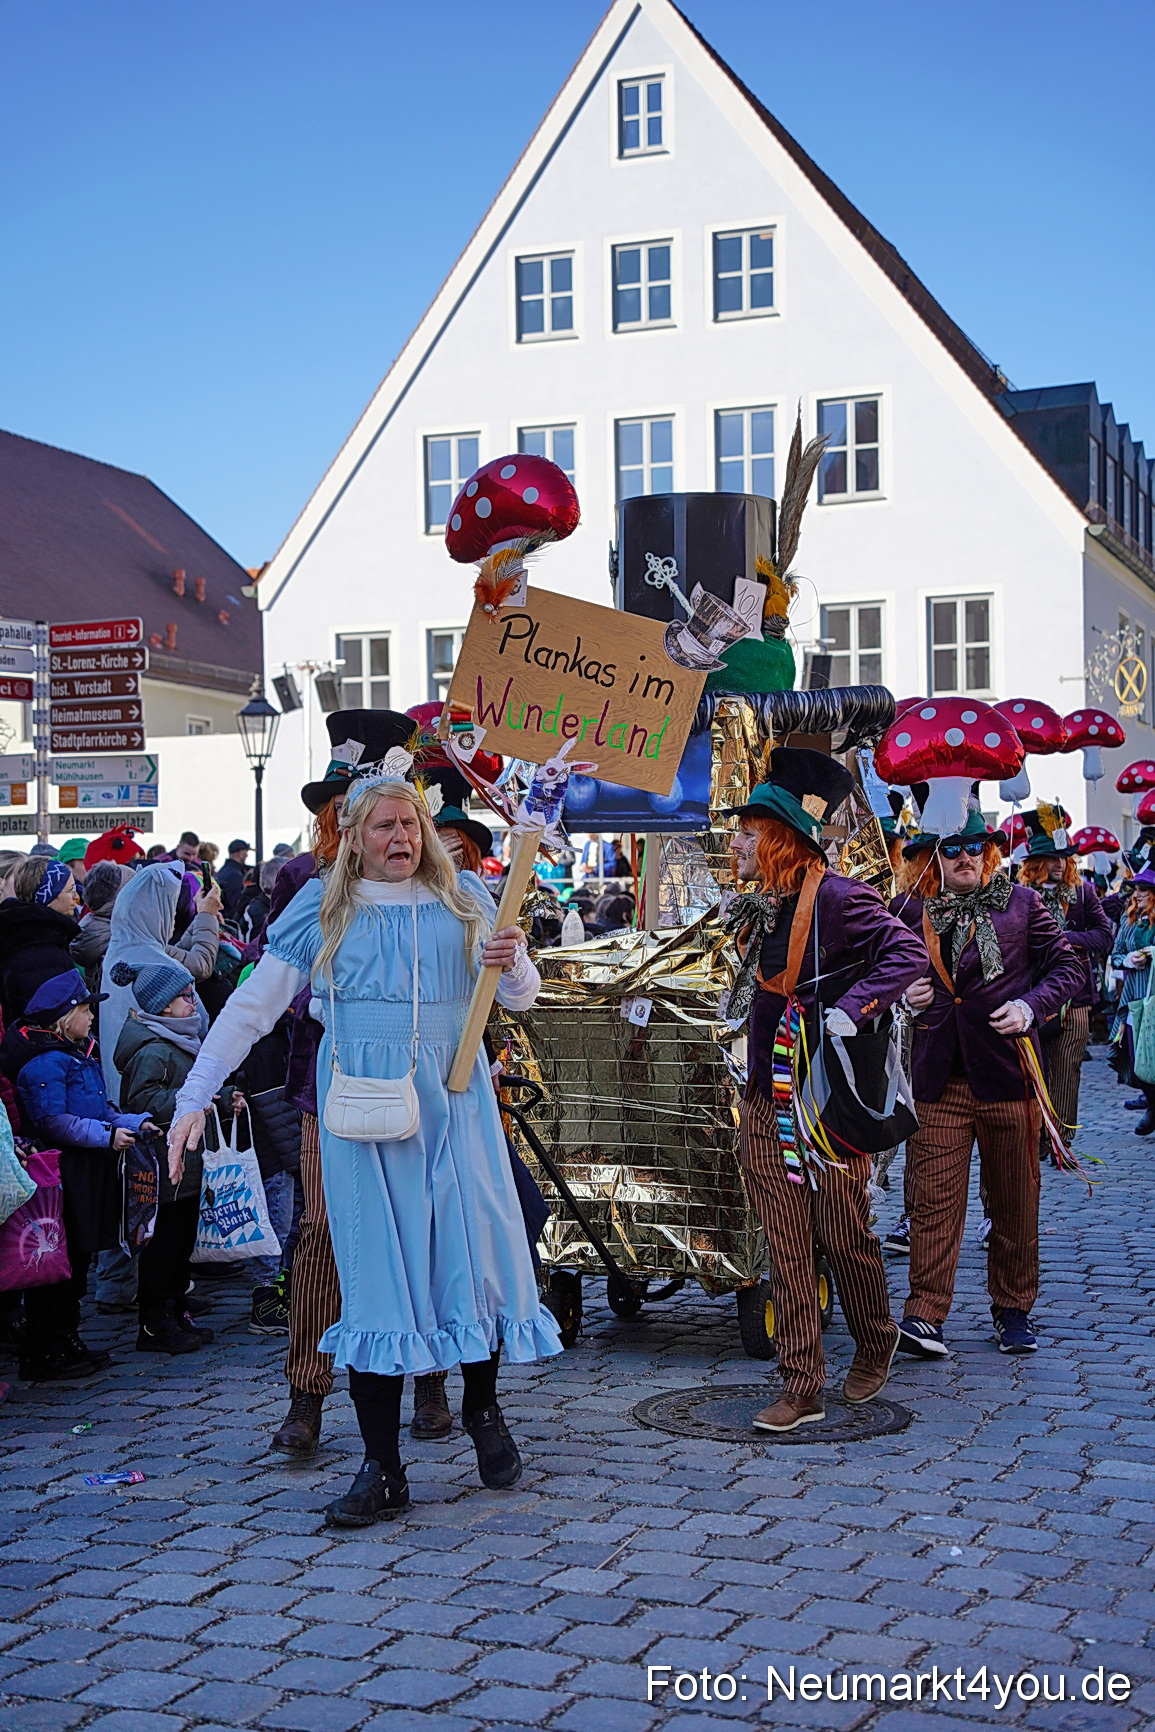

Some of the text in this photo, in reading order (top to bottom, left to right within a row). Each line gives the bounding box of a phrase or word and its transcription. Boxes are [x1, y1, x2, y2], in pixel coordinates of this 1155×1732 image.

[51, 628, 111, 643] Tourist-Information
[52, 653, 129, 671] St.-Lorenz-Kirche
[499, 613, 675, 705] Plankas im
[52, 678, 112, 697] hist. Vorstadt
[52, 708, 122, 723] Heimatmuseum
[477, 675, 671, 760] Wunderland
[52, 731, 127, 751] Stadtpfarrkirche
[56, 761, 95, 769] Neumarkt
[56, 772, 104, 781] Mühlhausen
[0, 817, 28, 833] platz
[218, 1210, 252, 1232] Park
